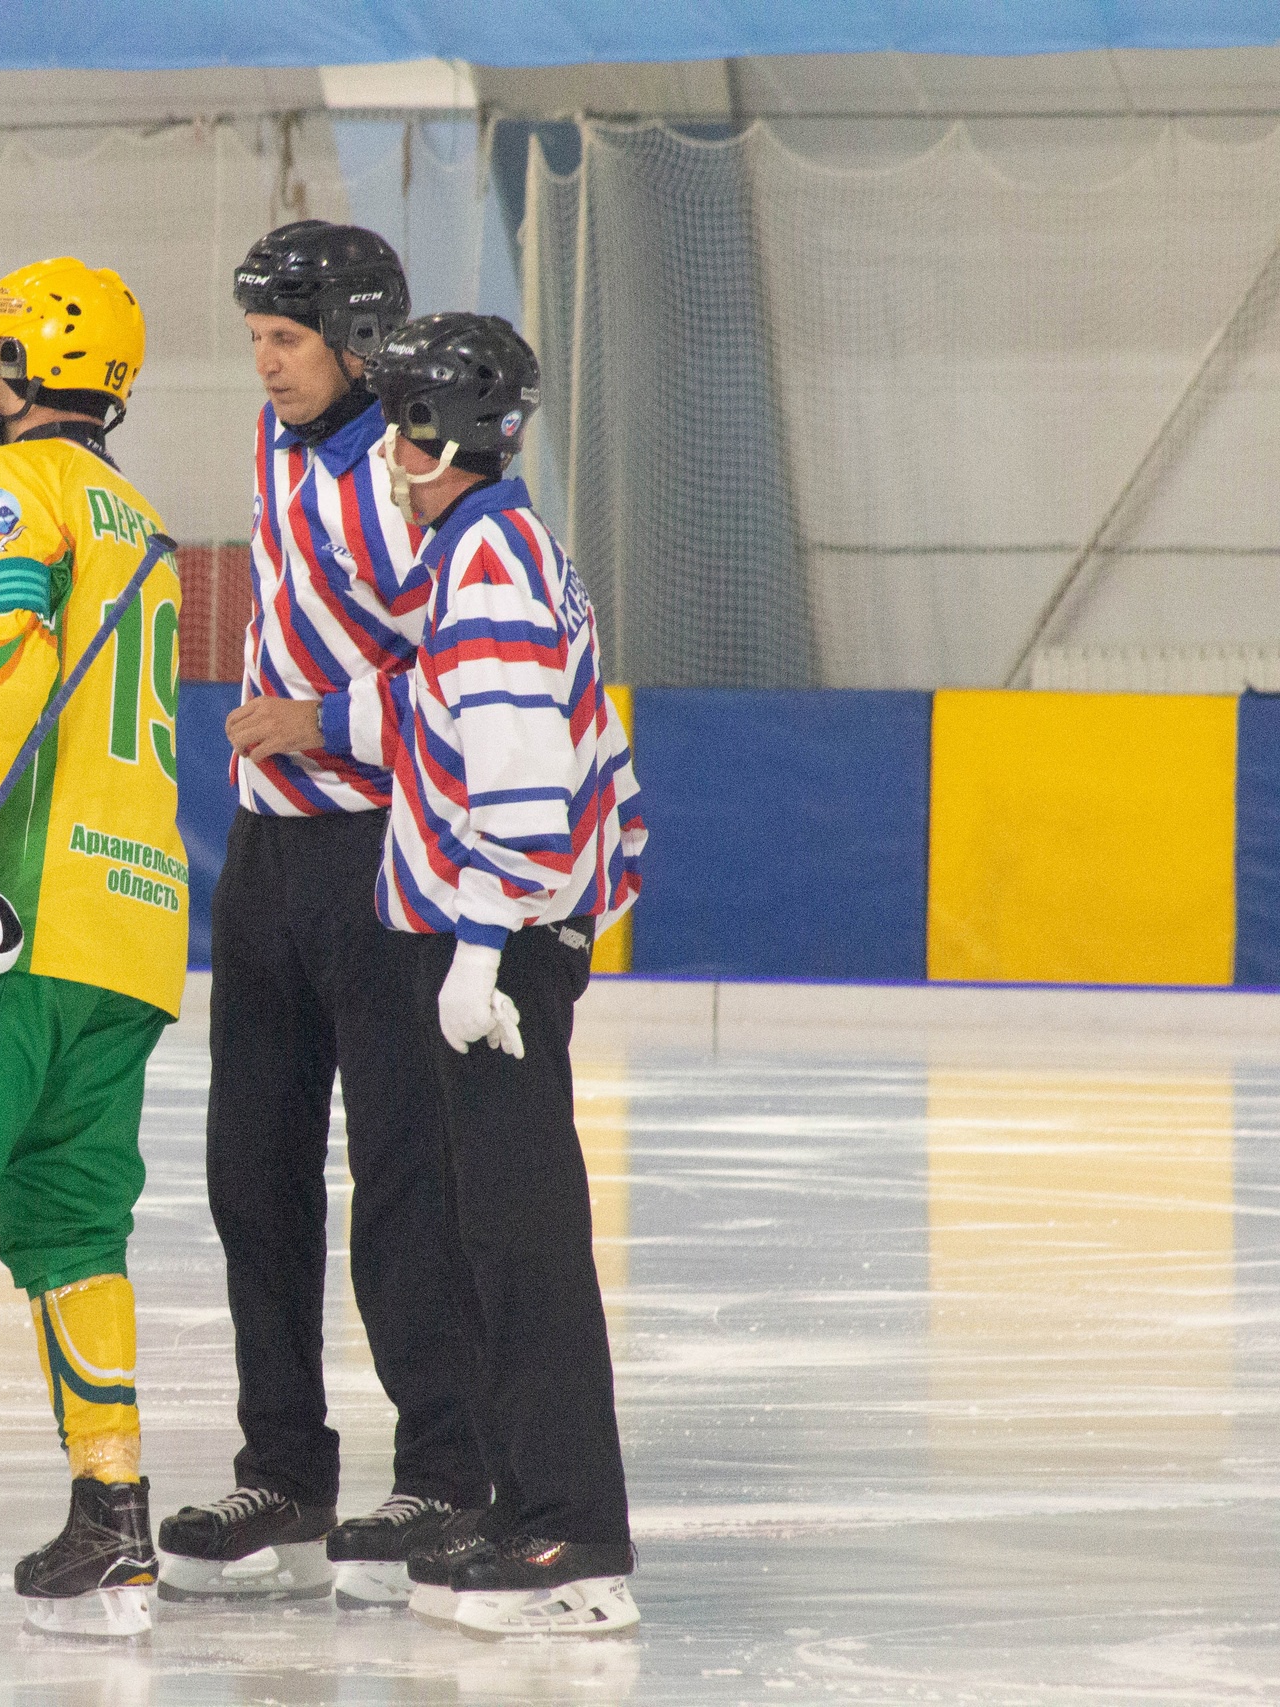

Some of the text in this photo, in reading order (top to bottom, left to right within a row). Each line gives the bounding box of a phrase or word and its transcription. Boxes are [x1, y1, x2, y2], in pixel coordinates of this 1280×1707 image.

[237, 272, 270, 286] CCM
[349, 291, 383, 303] CCM
[104, 359, 129, 391] 19
[101, 586, 180, 786] 19
[106, 866, 180, 913] область
